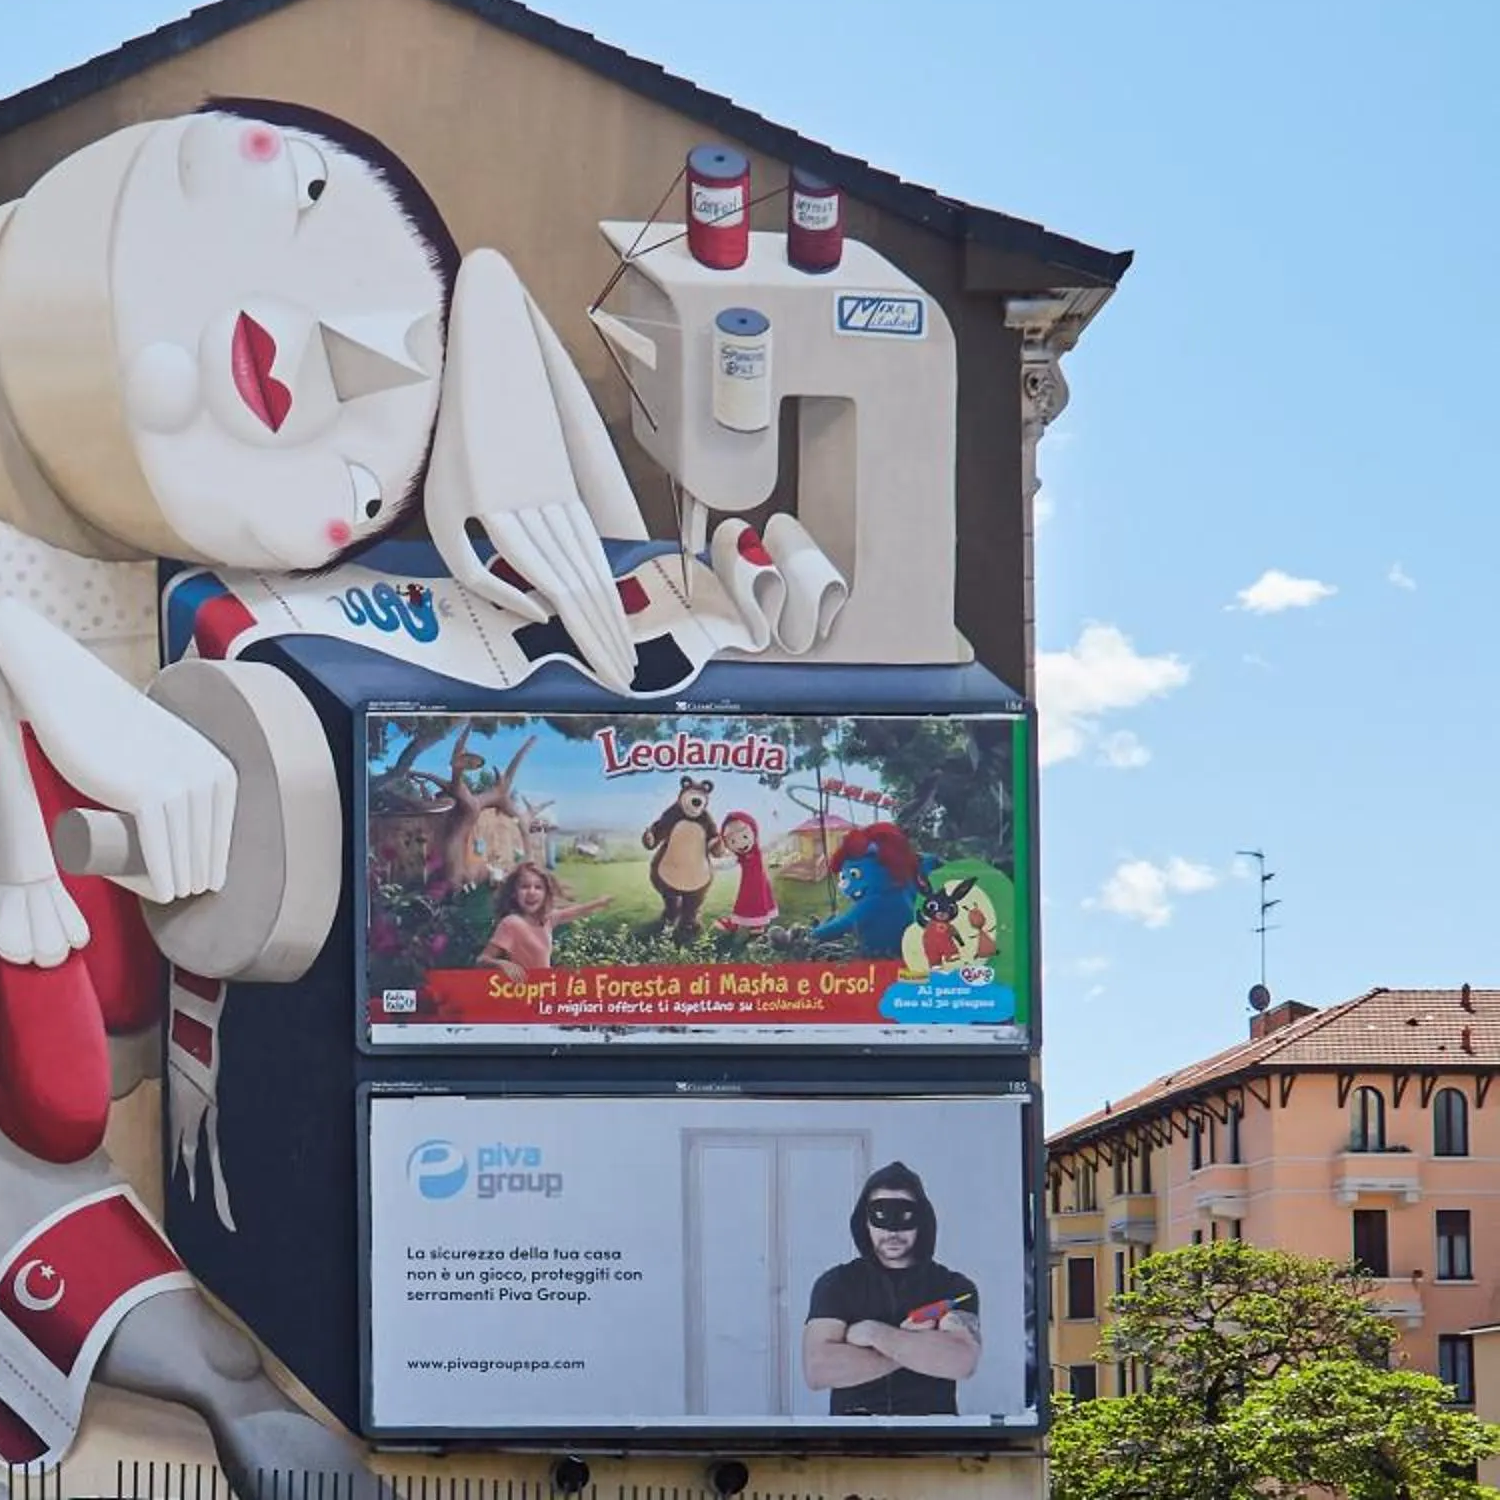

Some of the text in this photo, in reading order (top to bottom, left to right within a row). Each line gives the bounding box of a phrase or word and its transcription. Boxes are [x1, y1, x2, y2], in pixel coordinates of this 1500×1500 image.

[597, 728, 786, 773] Leolandia
[488, 964, 876, 1004] Scopri la Foresta di Masha e Orso!
[539, 1001, 552, 1015] Le
[557, 1000, 603, 1017] migliori
[608, 1000, 653, 1013] offerte
[658, 1000, 669, 1012] ti
[674, 1000, 734, 1016] aspettano
[739, 1001, 753, 1012] su
[1009, 1081, 1027, 1092] 185
[478, 1142, 542, 1171] piva
[477, 1173, 563, 1198] group
[407, 1247, 622, 1261] La sicurezza della tua casa
[407, 1267, 643, 1284] non è un gioco, proteggiti con
[407, 1288, 591, 1304] serramenti Piva Group.
[407, 1357, 585, 1373] www.pivagroupspa.com
